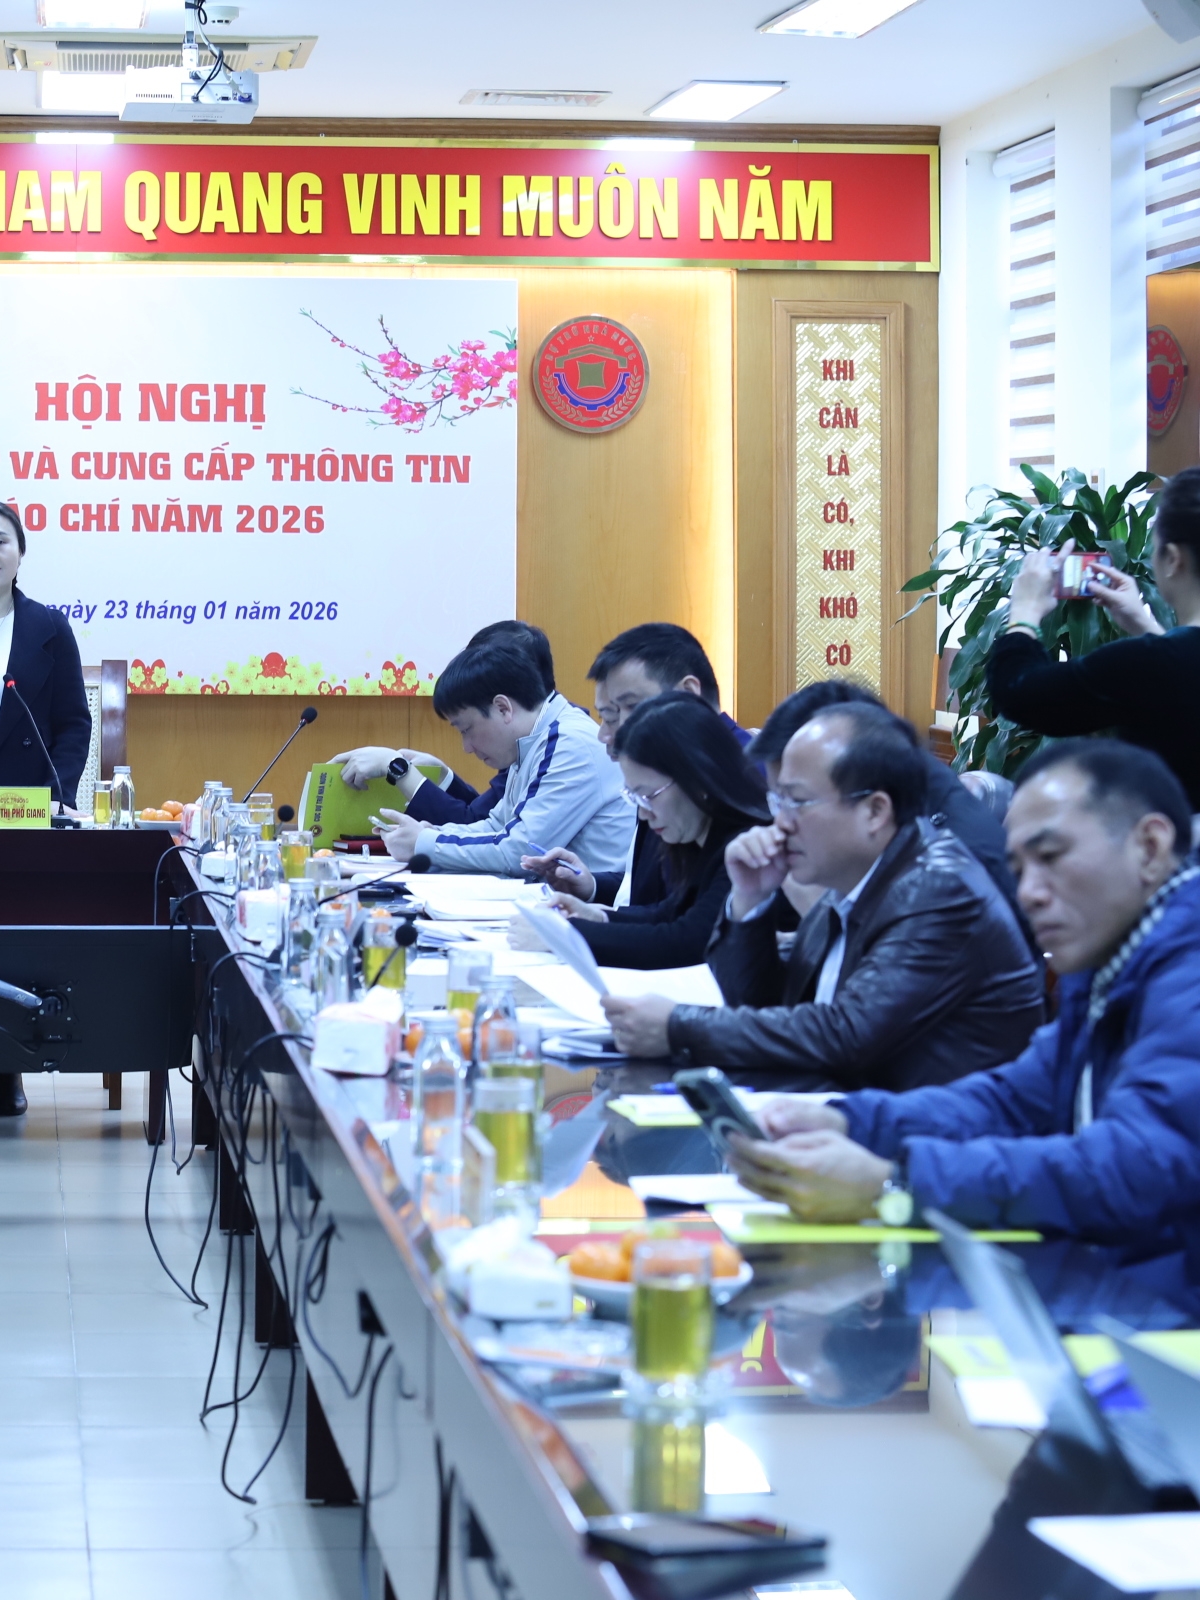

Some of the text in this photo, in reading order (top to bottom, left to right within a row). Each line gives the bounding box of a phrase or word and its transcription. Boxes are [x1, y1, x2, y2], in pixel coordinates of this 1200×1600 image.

[124, 170, 323, 241] QUANG
[343, 174, 481, 236] VINH
[501, 162, 679, 239] MUÔN
[698, 166, 833, 241] NĂM
[823, 360, 855, 381] KHI
[35, 374, 266, 430] HỘI NGHỊ
[819, 401, 858, 429] CẦN
[9, 445, 60, 480] VÀ
[71, 452, 171, 481] CUNG
[184, 442, 256, 481] CẤP
[266, 448, 394, 482] THÔNG
[406, 455, 472, 483] TIN
[827, 450, 850, 476] LÀ
[60, 497, 120, 532] CHÍ
[131, 498, 223, 533] NĂM
[237, 505, 325, 534] 2026
[823, 498, 855, 526] CÓ,
[823, 549, 855, 571] KHI
[104, 600, 129, 619] 23
[136, 599, 197, 625] tháng
[204, 601, 227, 620] 01
[235, 601, 281, 620] năm
[288, 602, 339, 621] 2026
[819, 592, 858, 619] KHÓ
[826, 638, 851, 666] CÓ
[26, 808, 46, 819] GIANG
